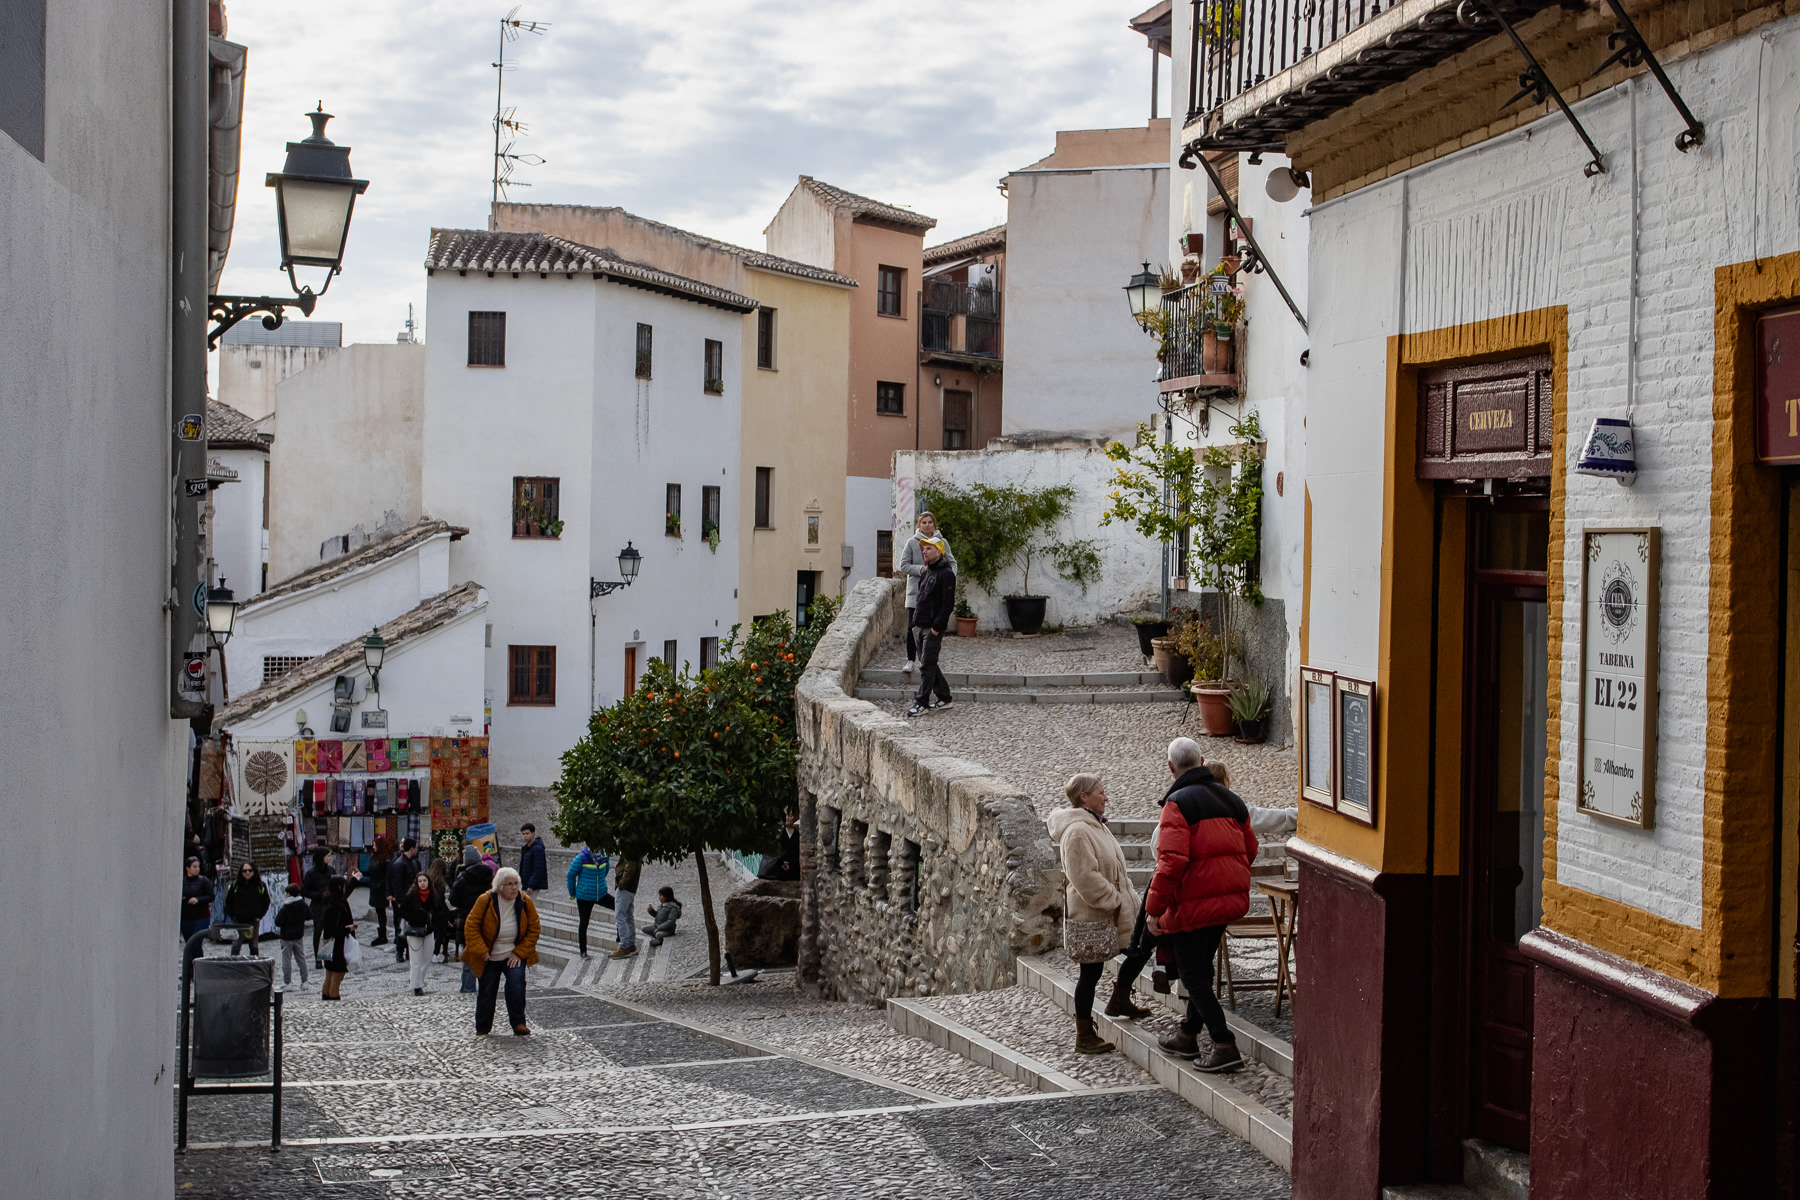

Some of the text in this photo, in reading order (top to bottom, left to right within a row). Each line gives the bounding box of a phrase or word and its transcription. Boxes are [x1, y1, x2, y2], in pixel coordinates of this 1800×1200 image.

[1470, 409, 1512, 430] CERVEZA
[1599, 653, 1634, 668] TABERNA
[1594, 677, 1638, 712] EL 22
[1603, 759, 1635, 779] Alhambra
